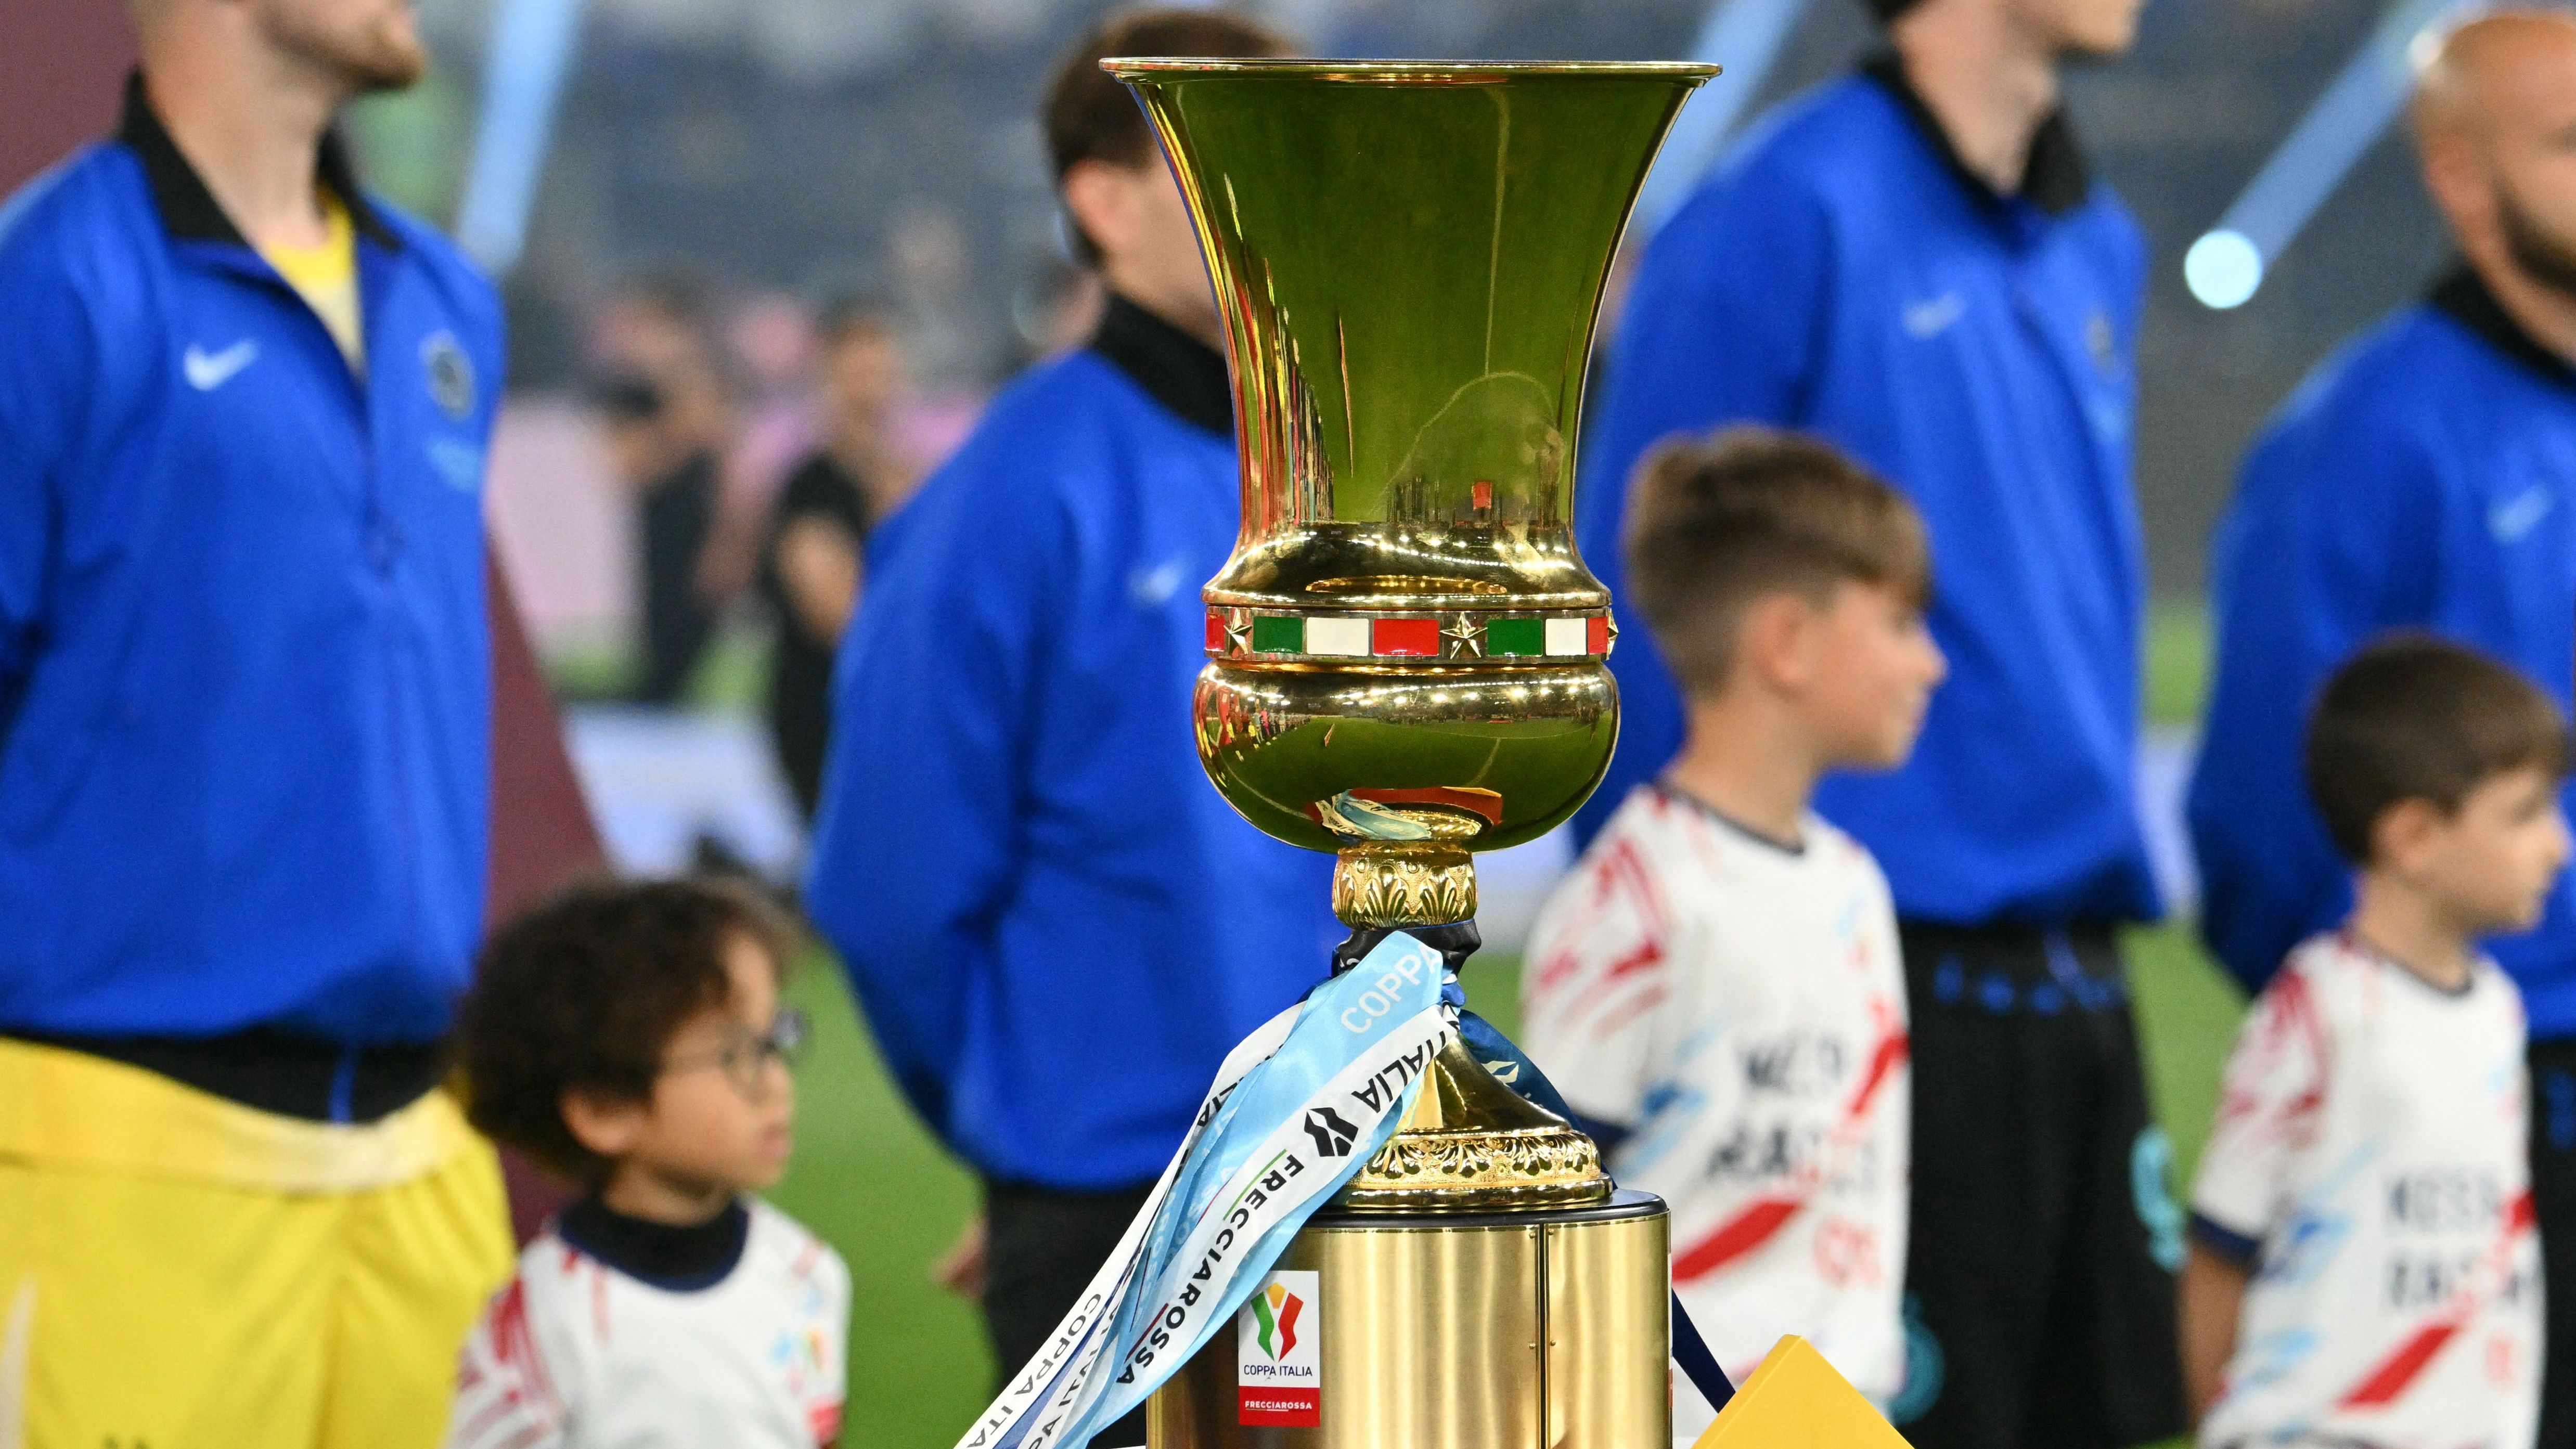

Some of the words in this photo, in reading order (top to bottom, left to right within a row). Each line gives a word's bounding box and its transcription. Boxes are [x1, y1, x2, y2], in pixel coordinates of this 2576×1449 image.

[1340, 943, 1443, 1033] COPPA
[1116, 1154, 1305, 1384] FRECCIAROSSA
[1014, 1293, 1101, 1395] COPPA
[1244, 1364, 1277, 1376] COPPA
[1279, 1365, 1313, 1377] ITALIA
[1245, 1401, 1312, 1409] FRECCIAROSSA
